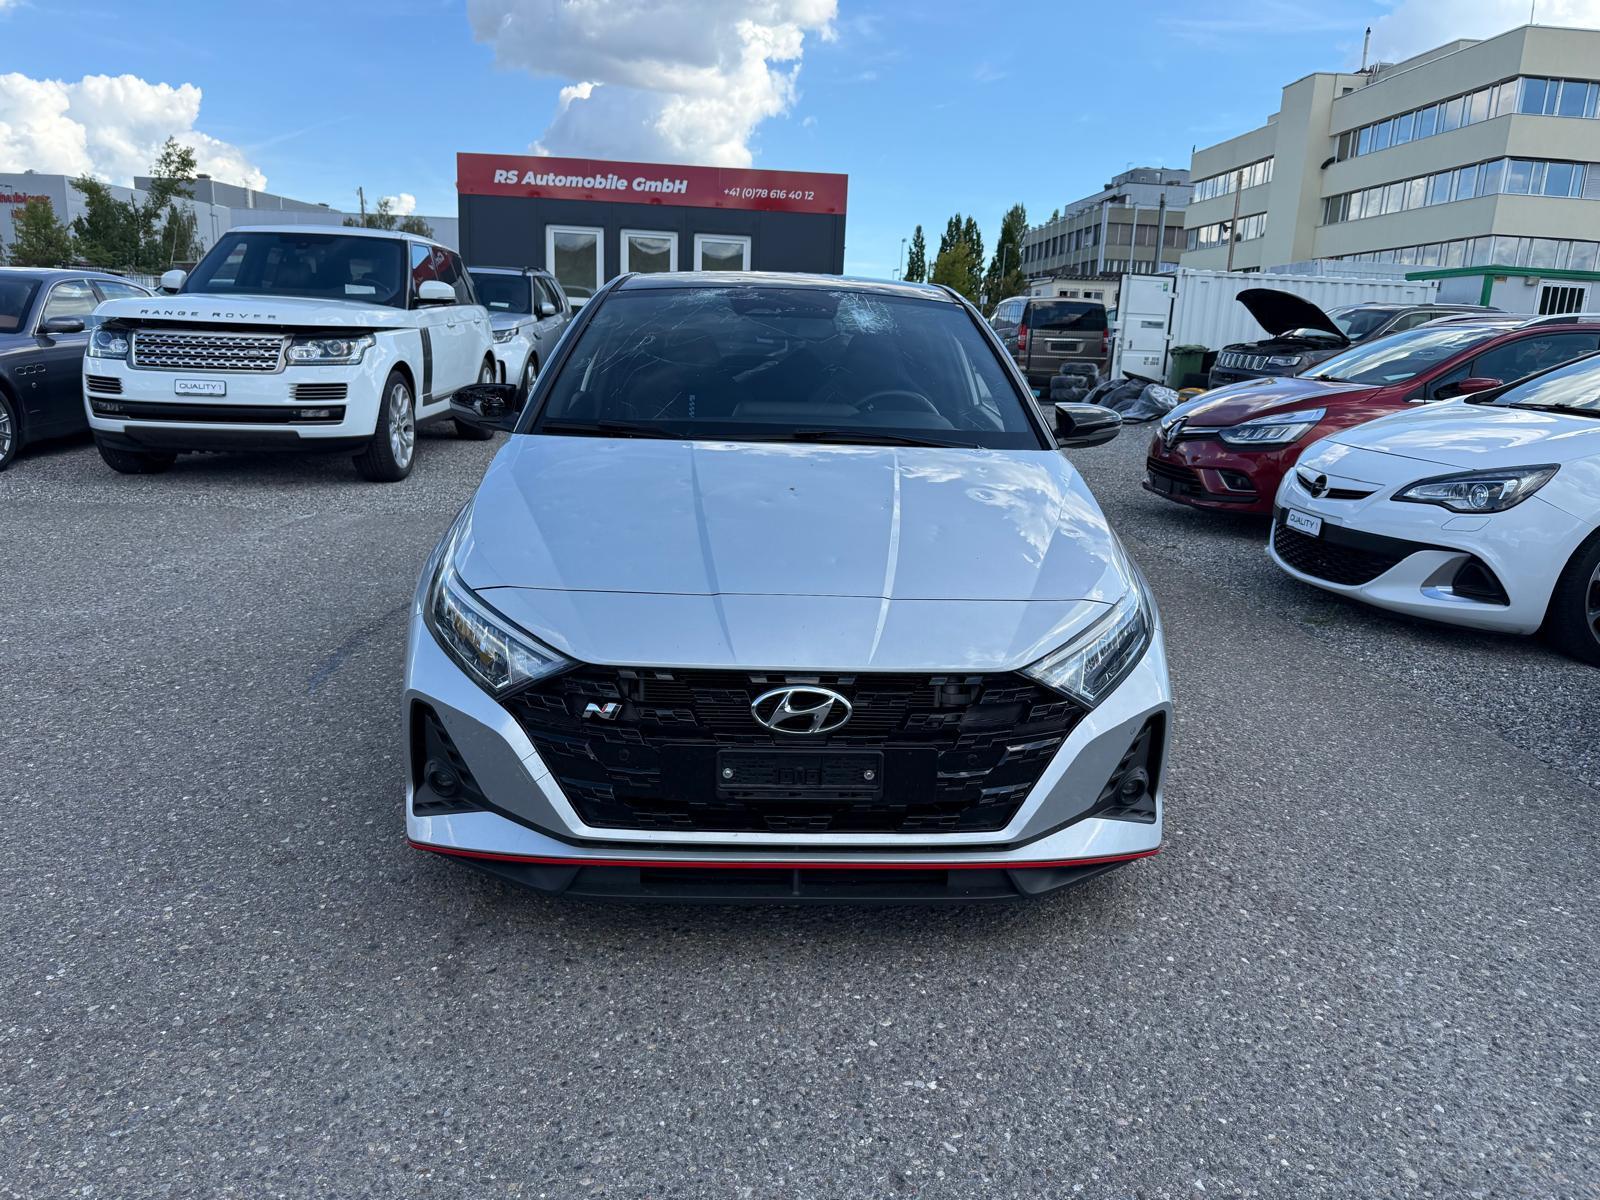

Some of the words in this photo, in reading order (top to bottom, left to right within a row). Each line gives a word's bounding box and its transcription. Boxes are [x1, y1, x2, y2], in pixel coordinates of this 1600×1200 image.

[494, 169, 519, 184] RS
[521, 171, 628, 190] Automobile
[632, 176, 688, 194] GmbH
[723, 187, 740, 197] +41
[742, 187, 768, 199] (0)78
[769, 189, 787, 199] 616
[788, 190, 802, 200] 40
[804, 191, 815, 200] 12
[140, 309, 199, 317] RANGE
[1290, 513, 1315, 528] QUALITY
